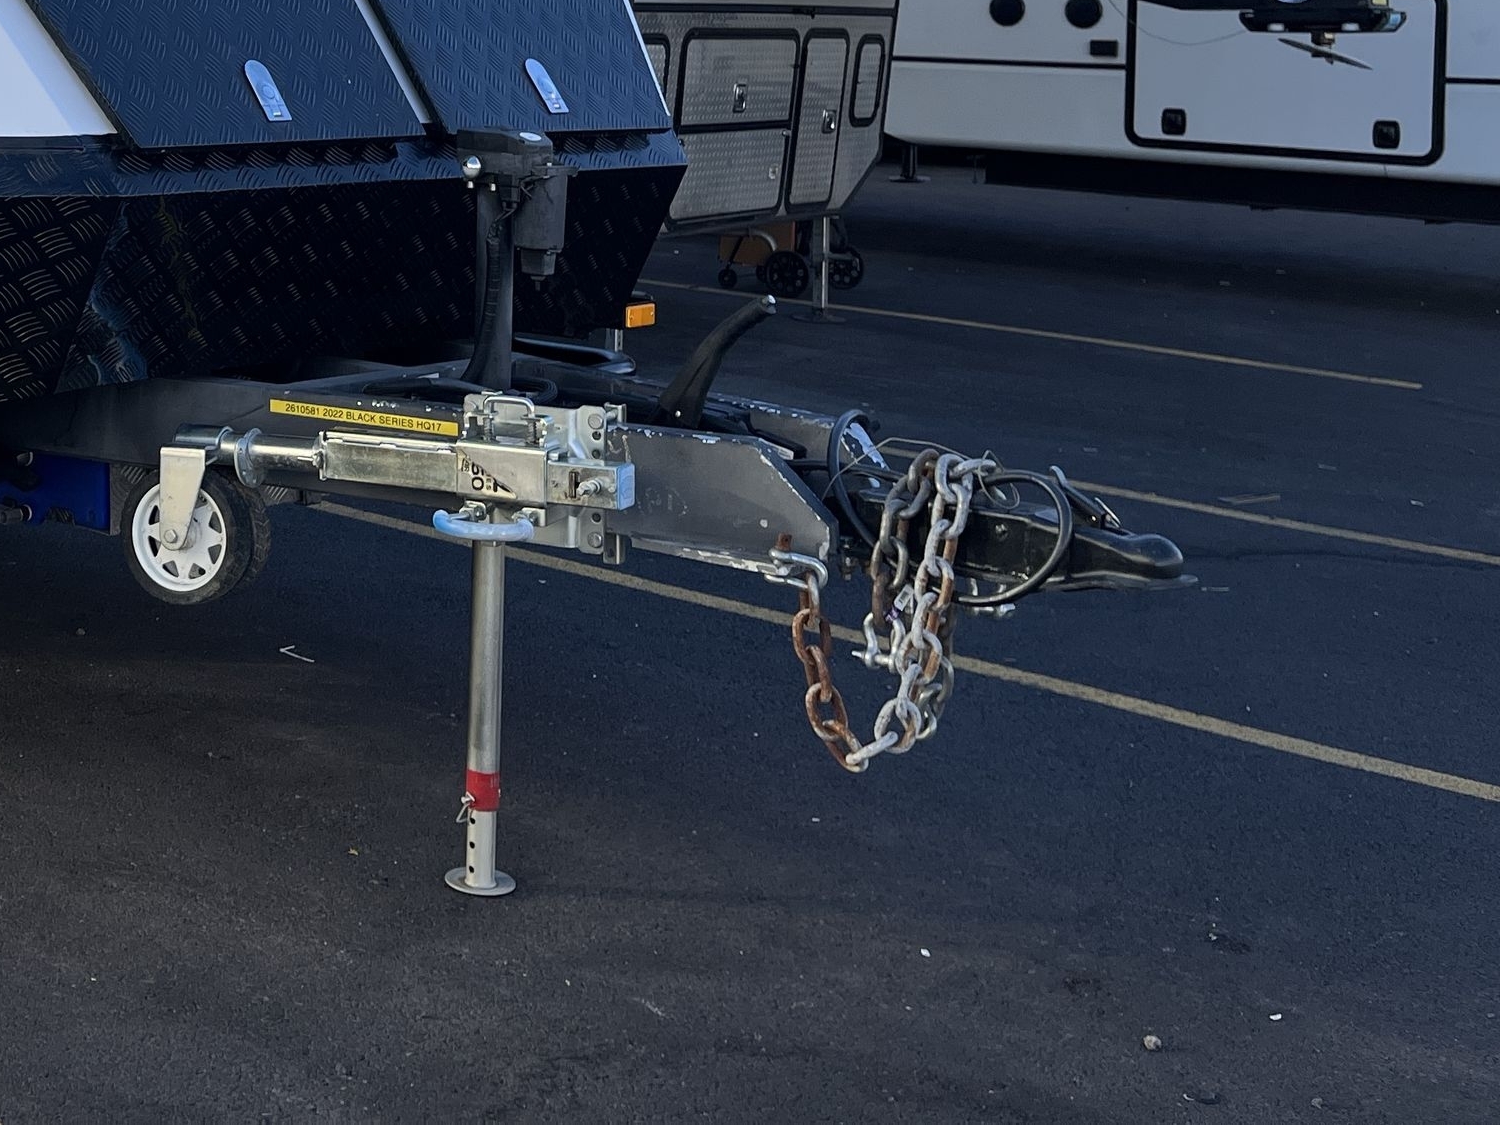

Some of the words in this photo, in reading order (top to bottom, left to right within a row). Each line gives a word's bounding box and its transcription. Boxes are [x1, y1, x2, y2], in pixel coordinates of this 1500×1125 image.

[285, 403, 320, 416] 2610581
[323, 408, 344, 419] 2022
[346, 411, 376, 424] BLACK
[379, 416, 414, 429] SERIES
[416, 420, 442, 432] HQ17
